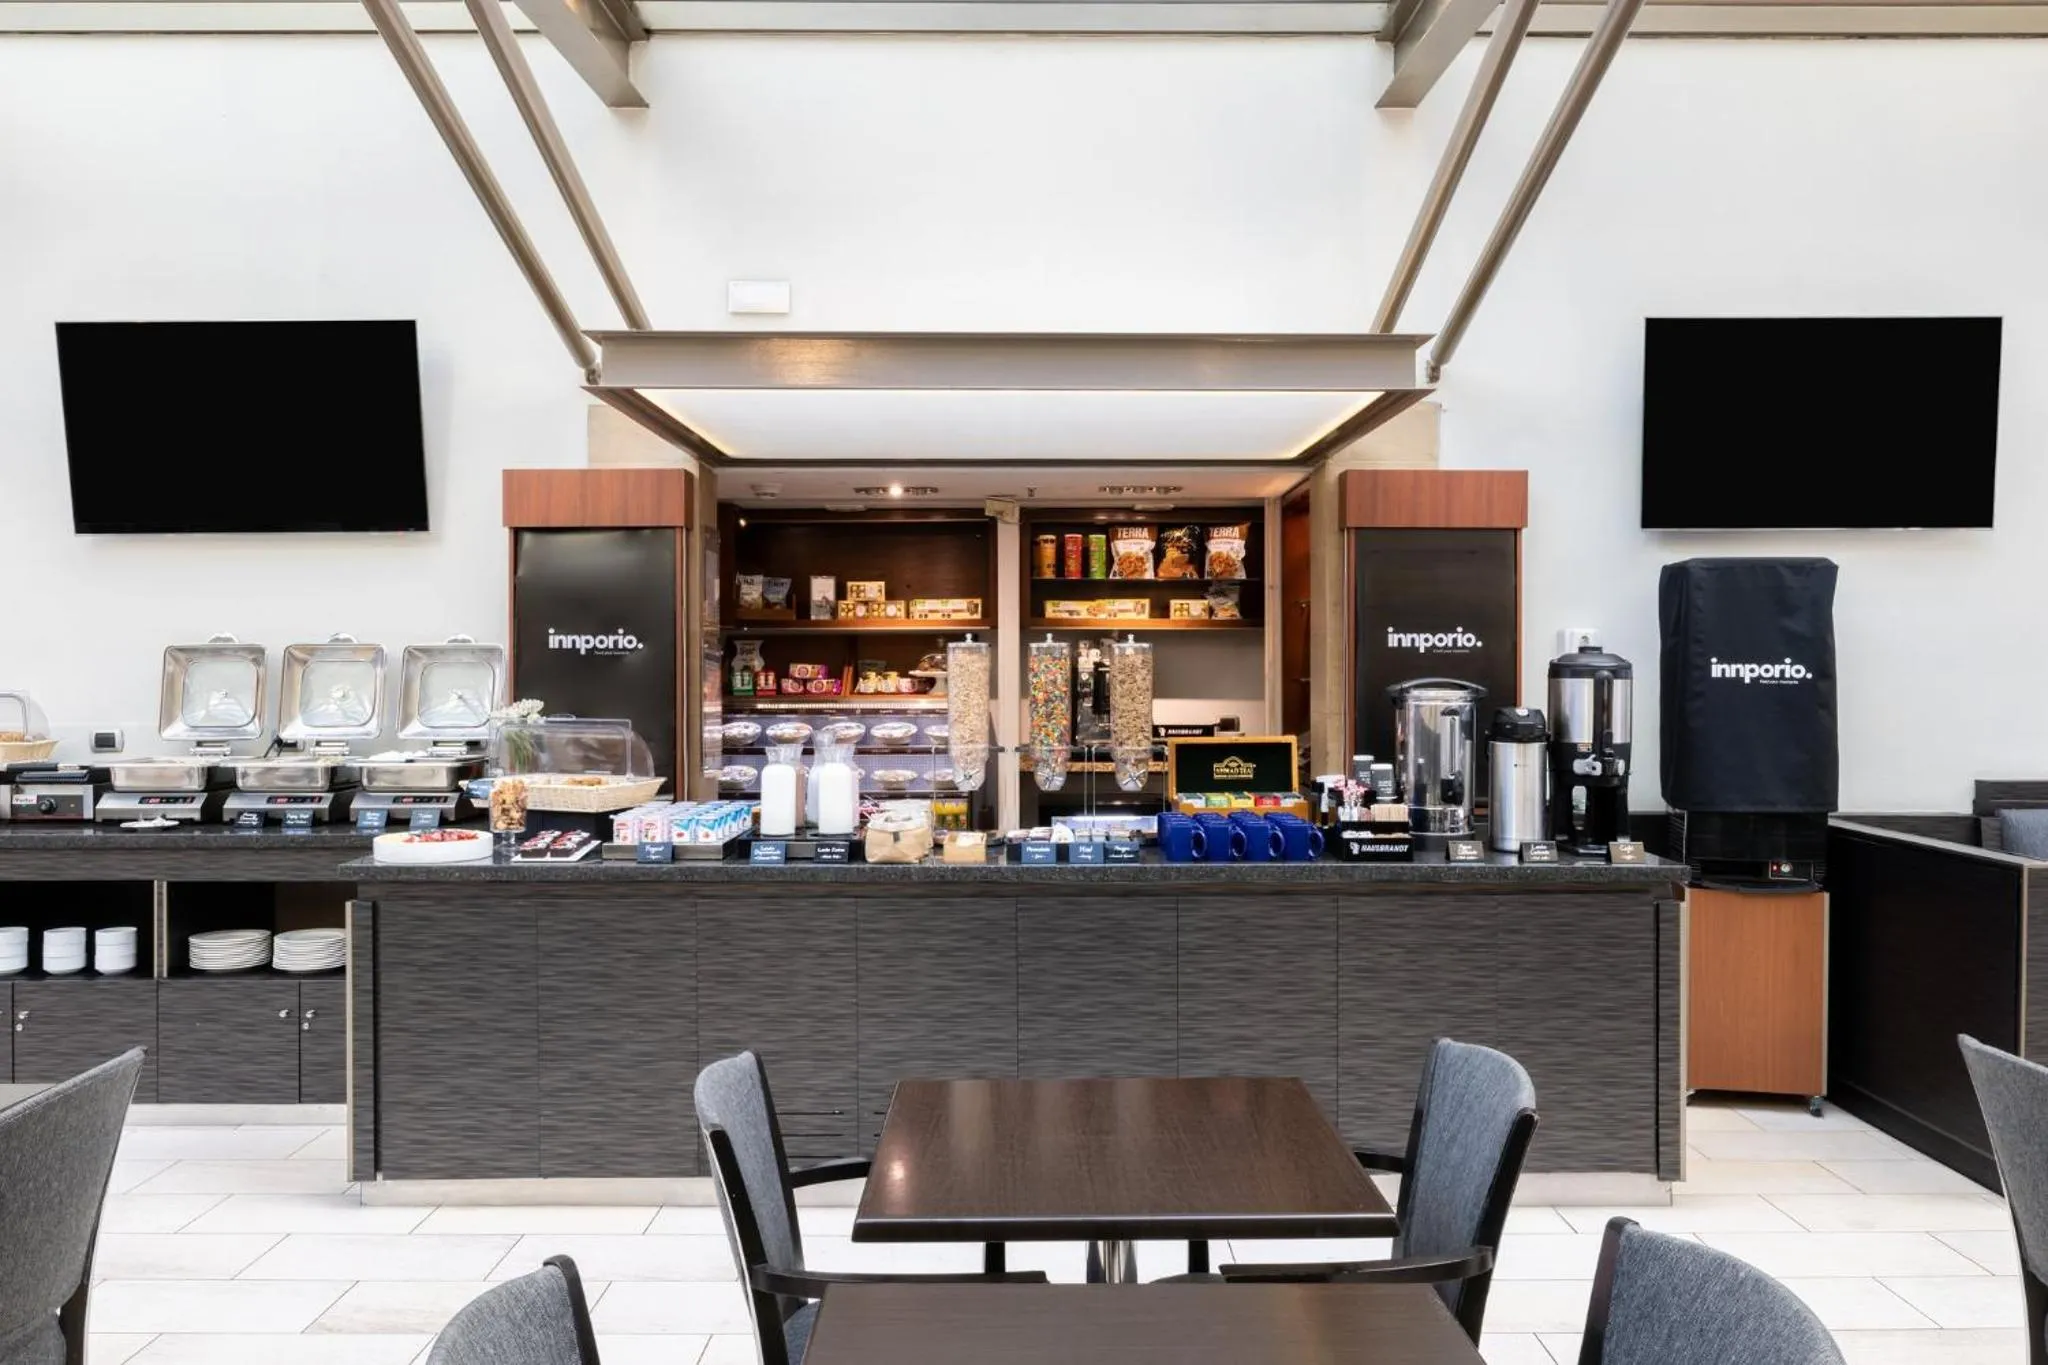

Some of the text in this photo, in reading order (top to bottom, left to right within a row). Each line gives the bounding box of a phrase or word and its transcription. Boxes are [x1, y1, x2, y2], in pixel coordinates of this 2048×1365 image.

[1117, 526, 1149, 539] TERRA
[548, 627, 644, 656] innporio.
[1387, 626, 1483, 653] innporio.
[1710, 657, 1813, 684] innporio.
[1361, 844, 1409, 852] HAUSBRANDT
